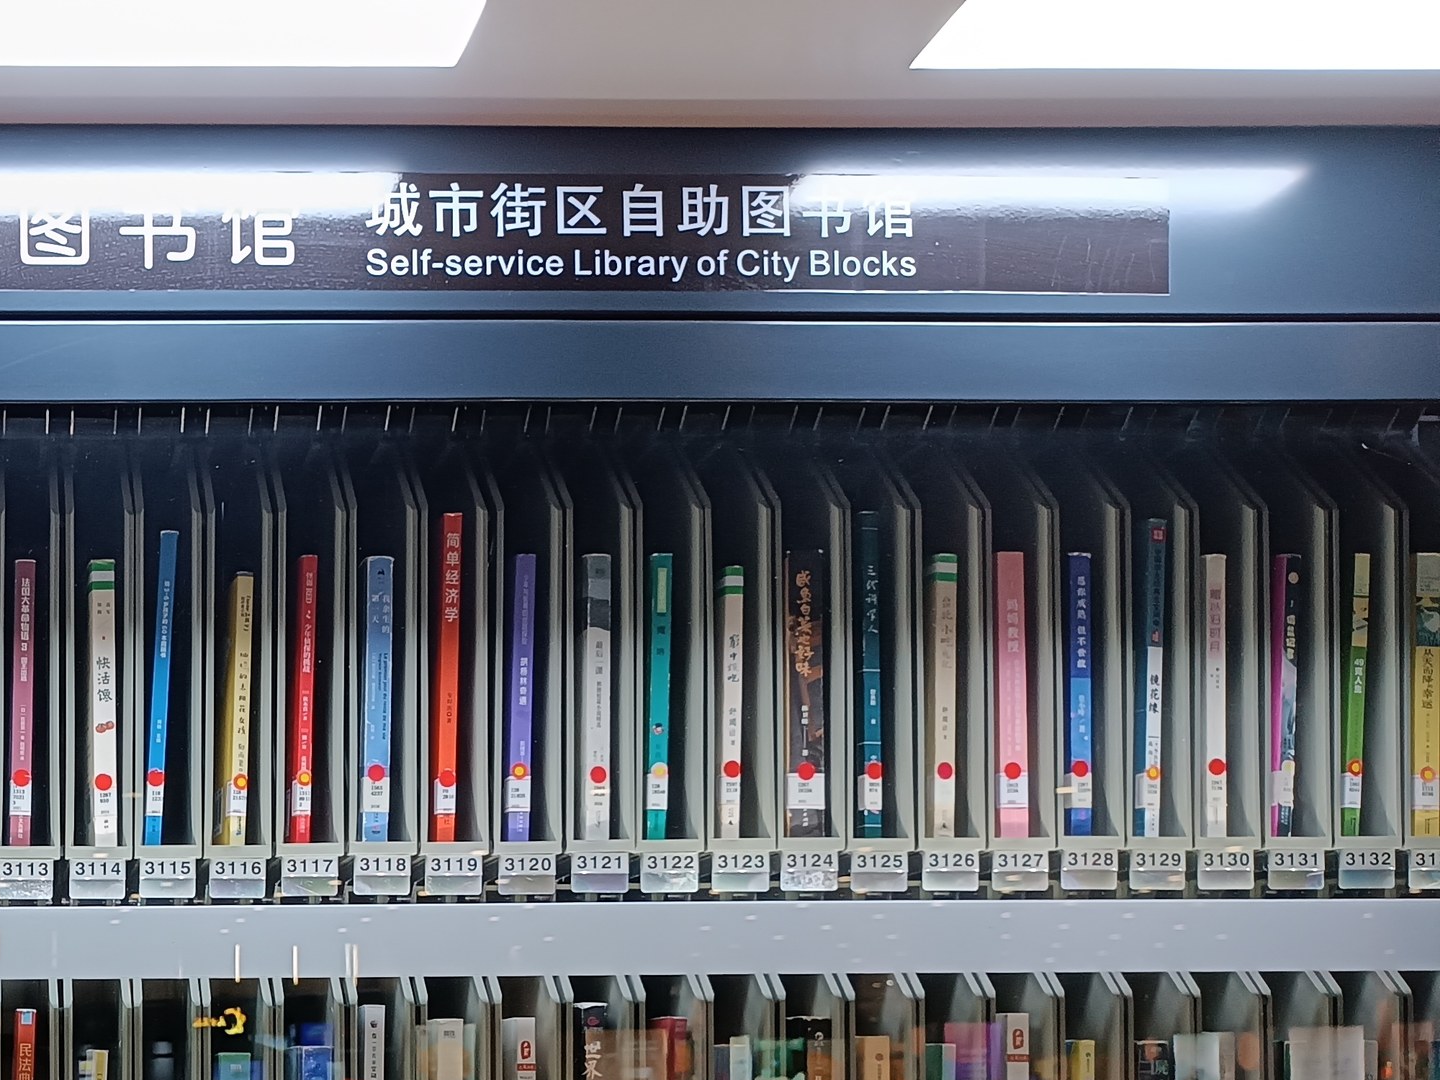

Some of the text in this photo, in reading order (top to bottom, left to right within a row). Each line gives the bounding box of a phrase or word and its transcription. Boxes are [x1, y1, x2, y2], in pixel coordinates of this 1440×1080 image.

[365, 183, 915, 237] 城市街区自助图书馆
[365, 248, 917, 282] Self-service Library of City Blocks
[445, 532, 460, 623] 简单经济学
[96, 656, 113, 703] 快活馋
[287, 859, 334, 873] 3117
[359, 857, 406, 872] 3118
[431, 857, 478, 872] 3119
[504, 857, 552, 872] 3120
[577, 855, 621, 869] 3121
[647, 855, 694, 870] 3122
[718, 854, 765, 869] 3123
[787, 853, 833, 868] 3124
[857, 854, 903, 868] 3125
[929, 853, 975, 867] 3126
[998, 853, 1044, 868] 3127
[1068, 852, 1114, 867] 3128
[1136, 852, 1181, 867] 3129
[1204, 852, 1250, 867] 3130
[1274, 852, 1318, 866] 3131
[1345, 851, 1391, 866] 3132
[2, 862, 49, 876] 3113
[75, 861, 121, 876] 3114
[144, 860, 191, 875] 3115
[215, 861, 262, 875] 3116
